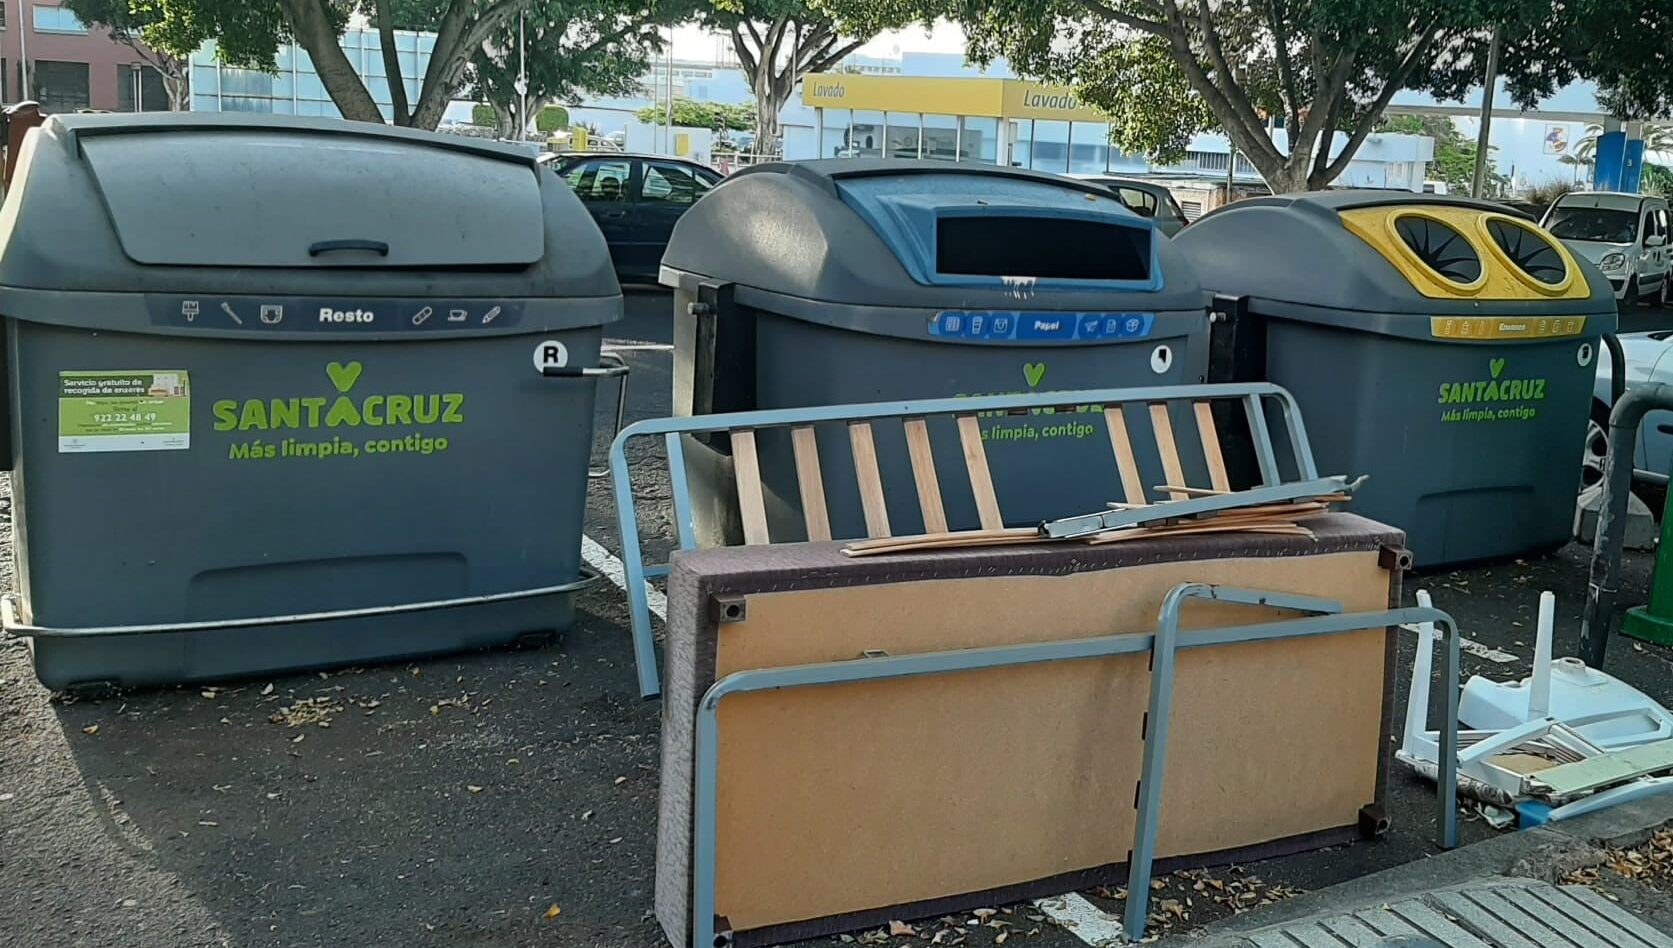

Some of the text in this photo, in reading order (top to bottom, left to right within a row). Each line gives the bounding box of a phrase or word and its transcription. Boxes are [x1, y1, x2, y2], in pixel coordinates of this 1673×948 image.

[812, 81, 845, 99] Lavado
[1023, 89, 1078, 110] Lavado
[319, 307, 375, 324] Resto
[1034, 319, 1061, 331] Papel
[543, 345, 559, 364] R
[63, 378, 143, 389] Servicio gratuito de
[63, 387, 101, 396] recogida
[94, 413, 112, 423] 922
[114, 413, 127, 422] 22
[144, 412, 157, 421] 49
[1441, 404, 1536, 422] Más limpia, contigo
[991, 424, 1039, 441] limpia,
[1042, 421, 1094, 439] contigo
[229, 432, 448, 460] Más limpia, contigo
